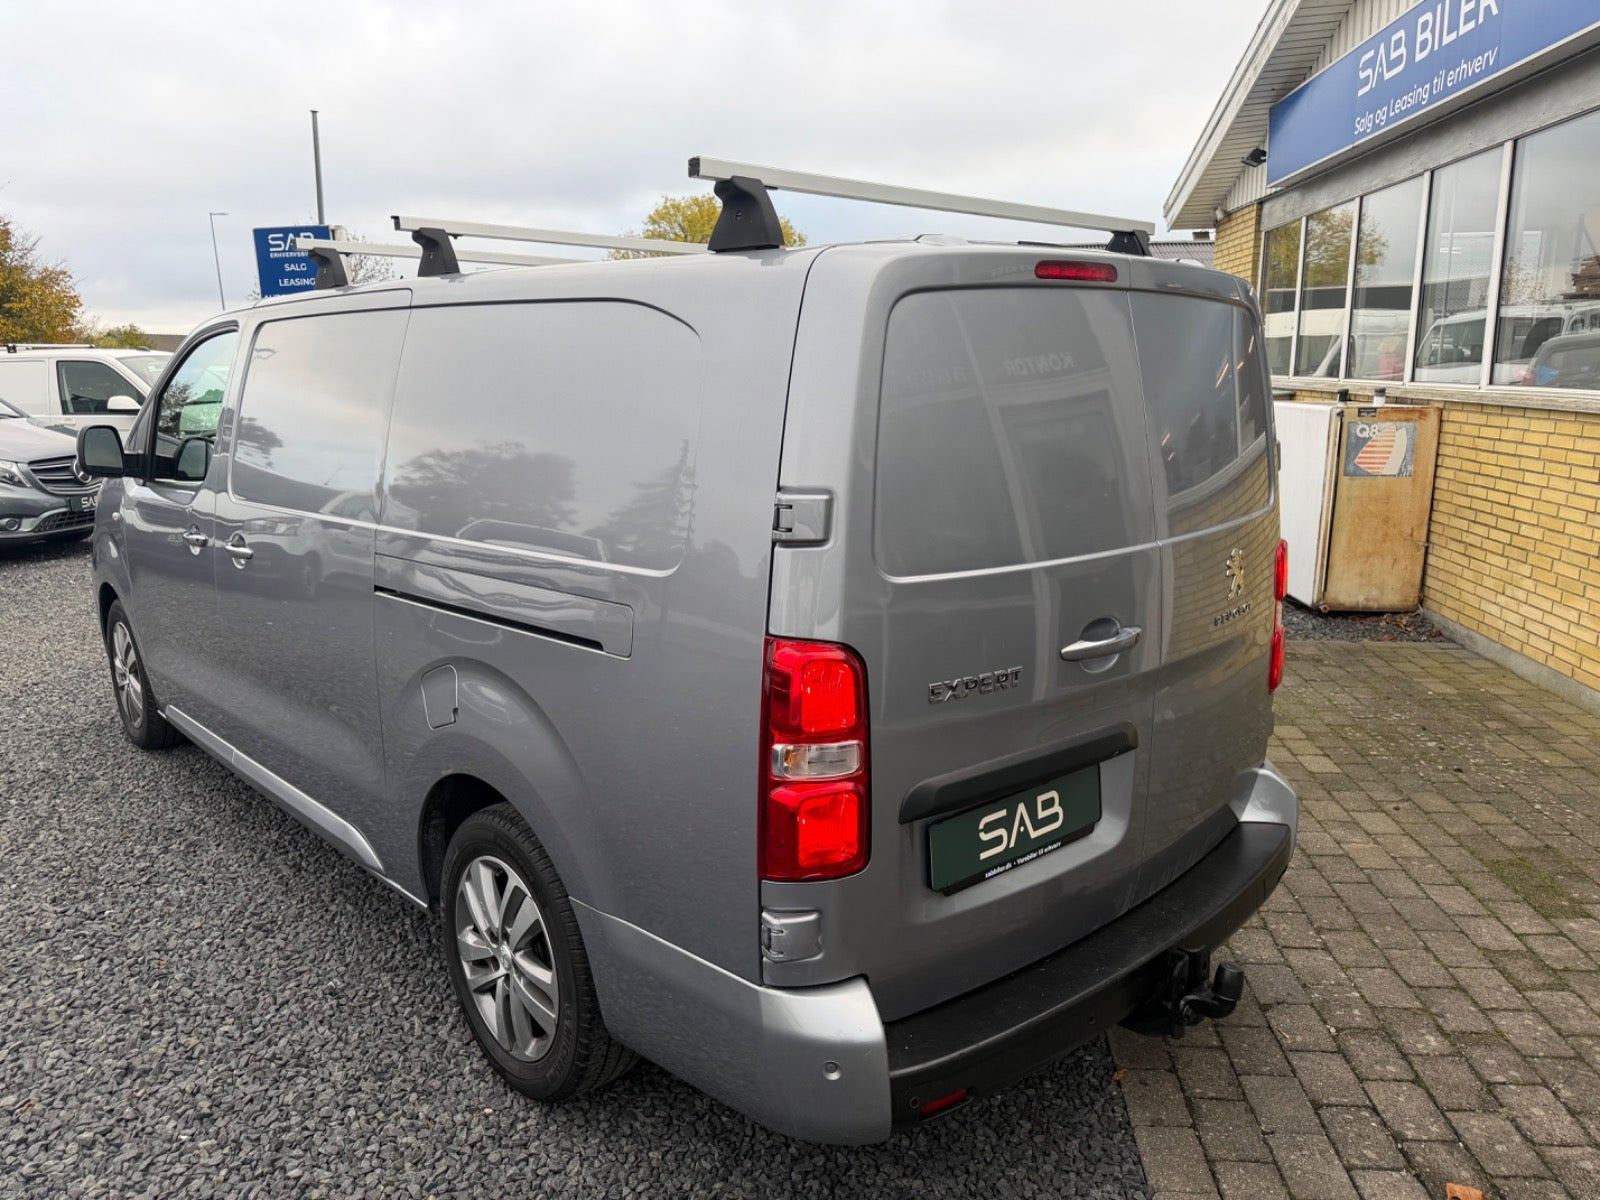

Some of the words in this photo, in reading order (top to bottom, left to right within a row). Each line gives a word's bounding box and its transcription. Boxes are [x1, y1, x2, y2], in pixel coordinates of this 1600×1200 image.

[1358, 29, 1407, 97] SAB
[1354, 112, 1374, 135] Salg
[1375, 106, 1388, 126] og
[1389, 82, 1431, 117] Leasing
[1432, 69, 1446, 96] til
[1446, 46, 1499, 87] erhverv
[284, 263, 307, 271] SALG
[279, 278, 316, 287] LEASING
[1356, 424, 1379, 438] Q8
[81, 496, 98, 508] SA
[929, 665, 1023, 704] EXPERT
[979, 790, 1064, 860] SAB
